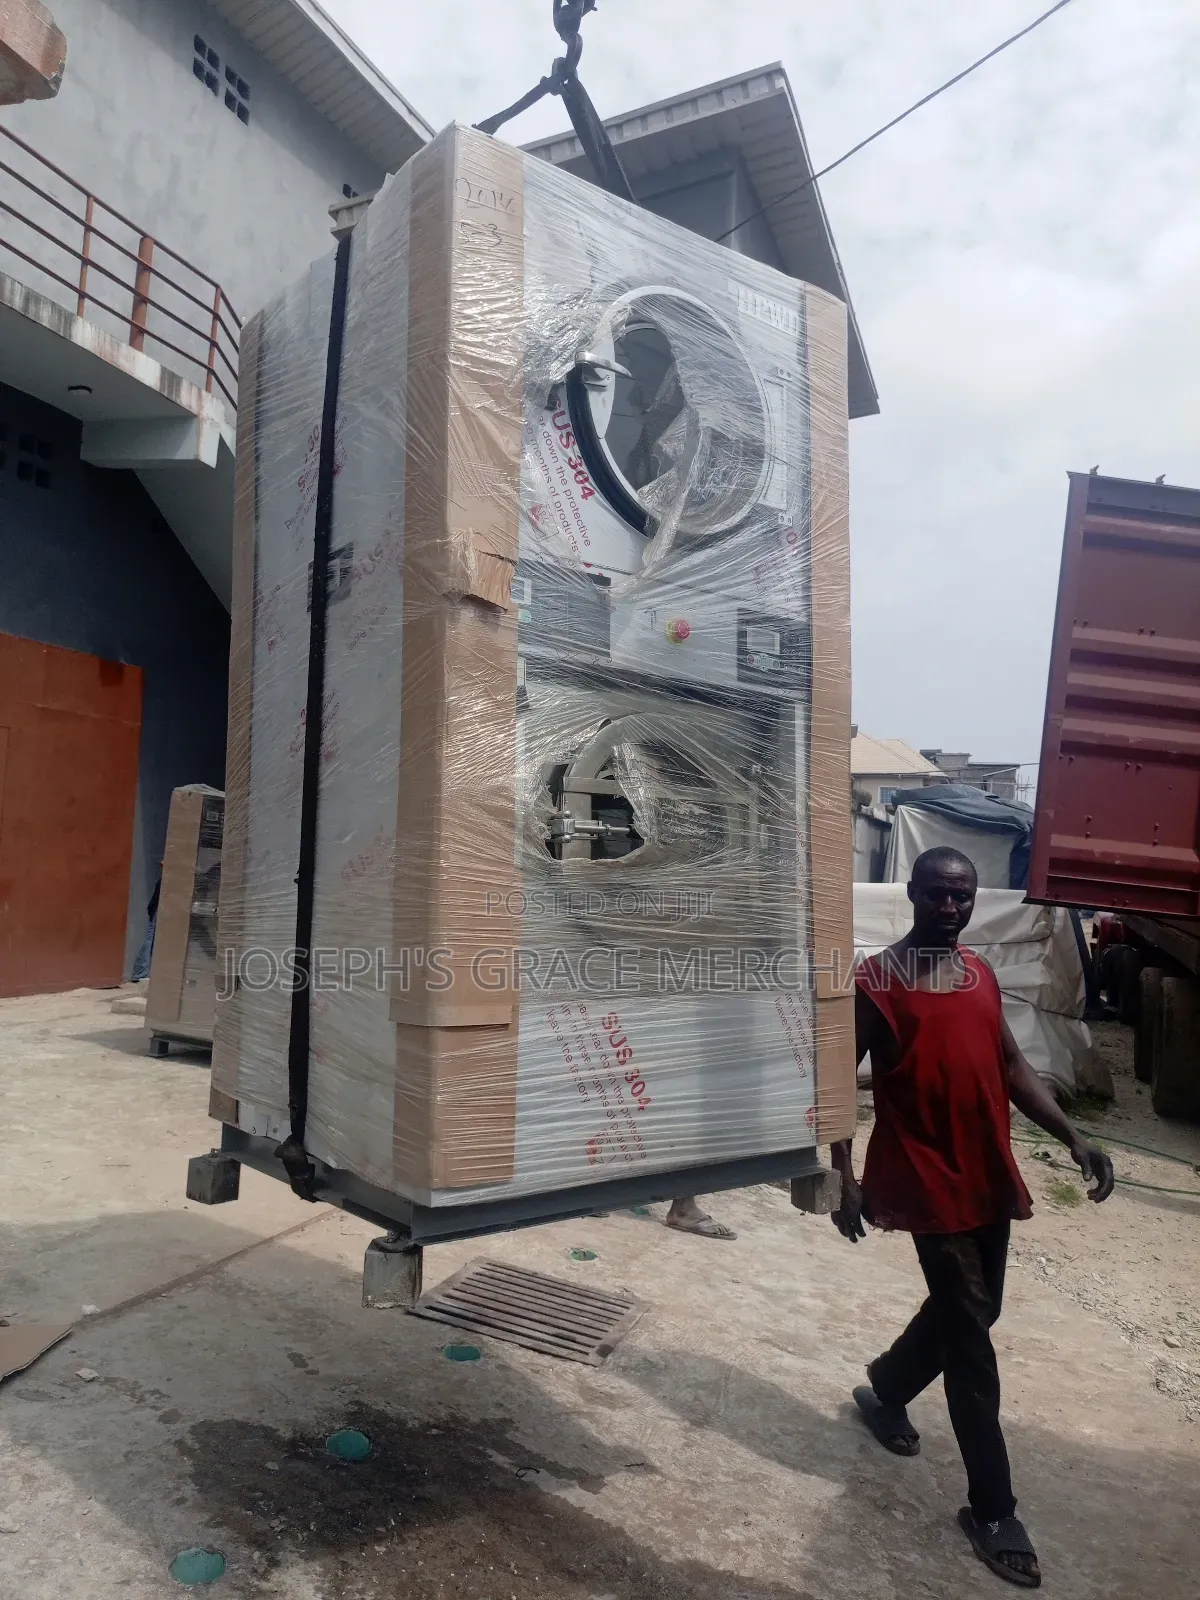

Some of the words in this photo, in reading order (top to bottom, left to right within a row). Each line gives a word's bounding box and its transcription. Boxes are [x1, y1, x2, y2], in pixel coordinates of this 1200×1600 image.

[530, 438, 553, 484] months
[548, 485, 560, 498] of
[542, 430, 559, 464] down
[556, 466, 568, 487] the
[562, 488, 591, 547] protective
[567, 454, 596, 501] 304
[561, 1041, 574, 1064] the
[600, 1011, 633, 1066] SUS
[625, 1068, 652, 1112] 304
[613, 1085, 626, 1105] the
